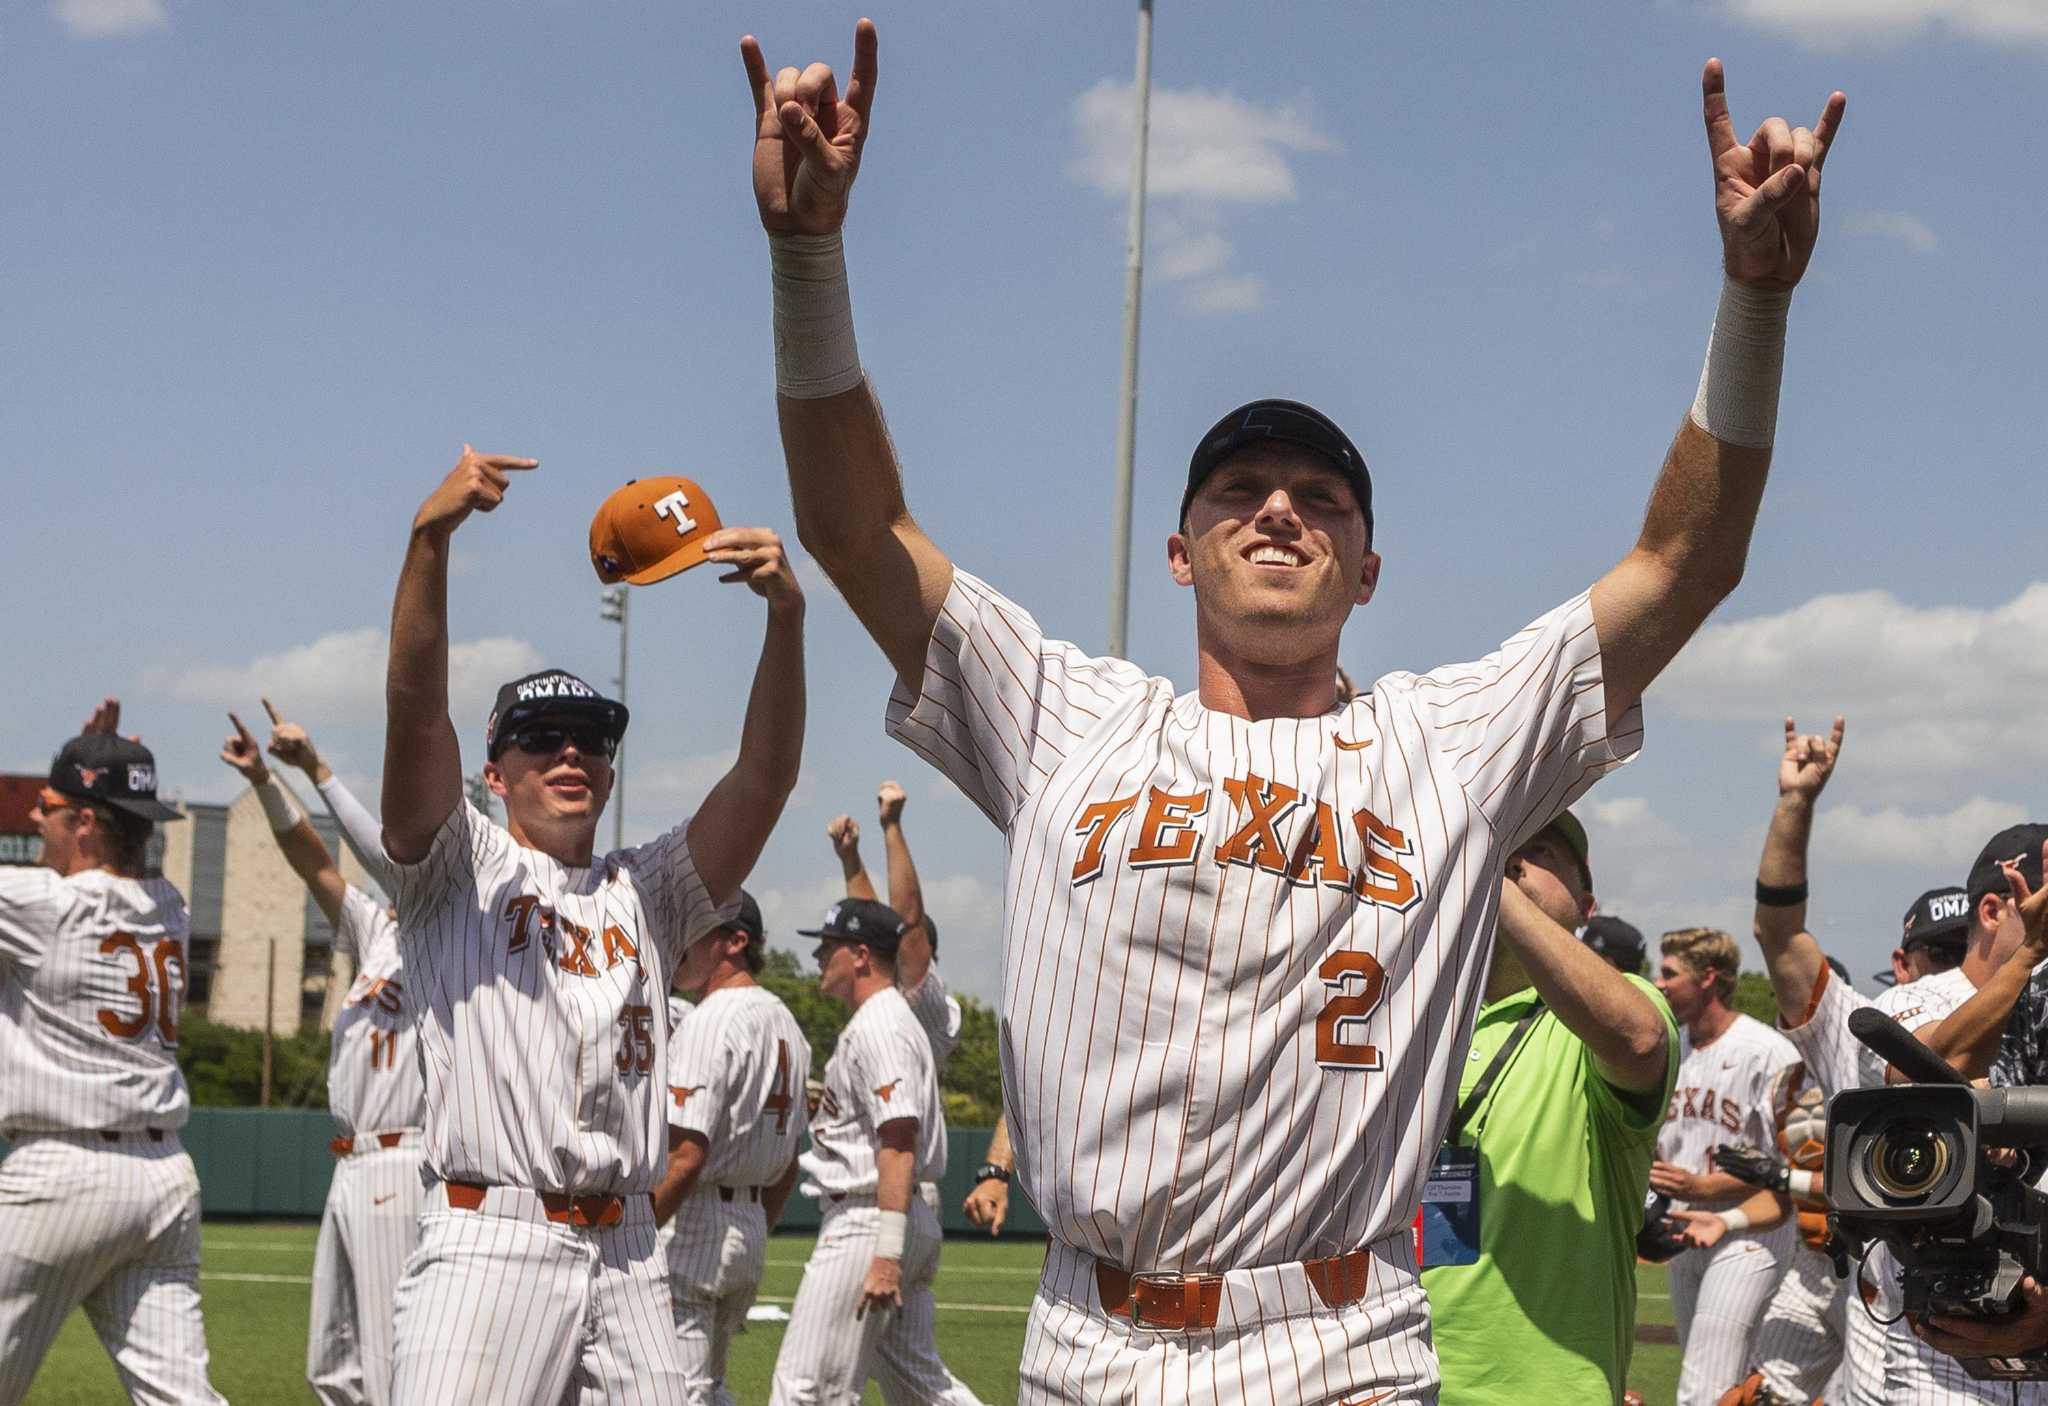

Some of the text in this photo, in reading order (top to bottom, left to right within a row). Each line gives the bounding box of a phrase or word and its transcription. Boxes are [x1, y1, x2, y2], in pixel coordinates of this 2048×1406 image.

[653, 490, 697, 536] T
[1072, 772, 1423, 913] TEXAS
[1315, 950, 1388, 1071] 2
